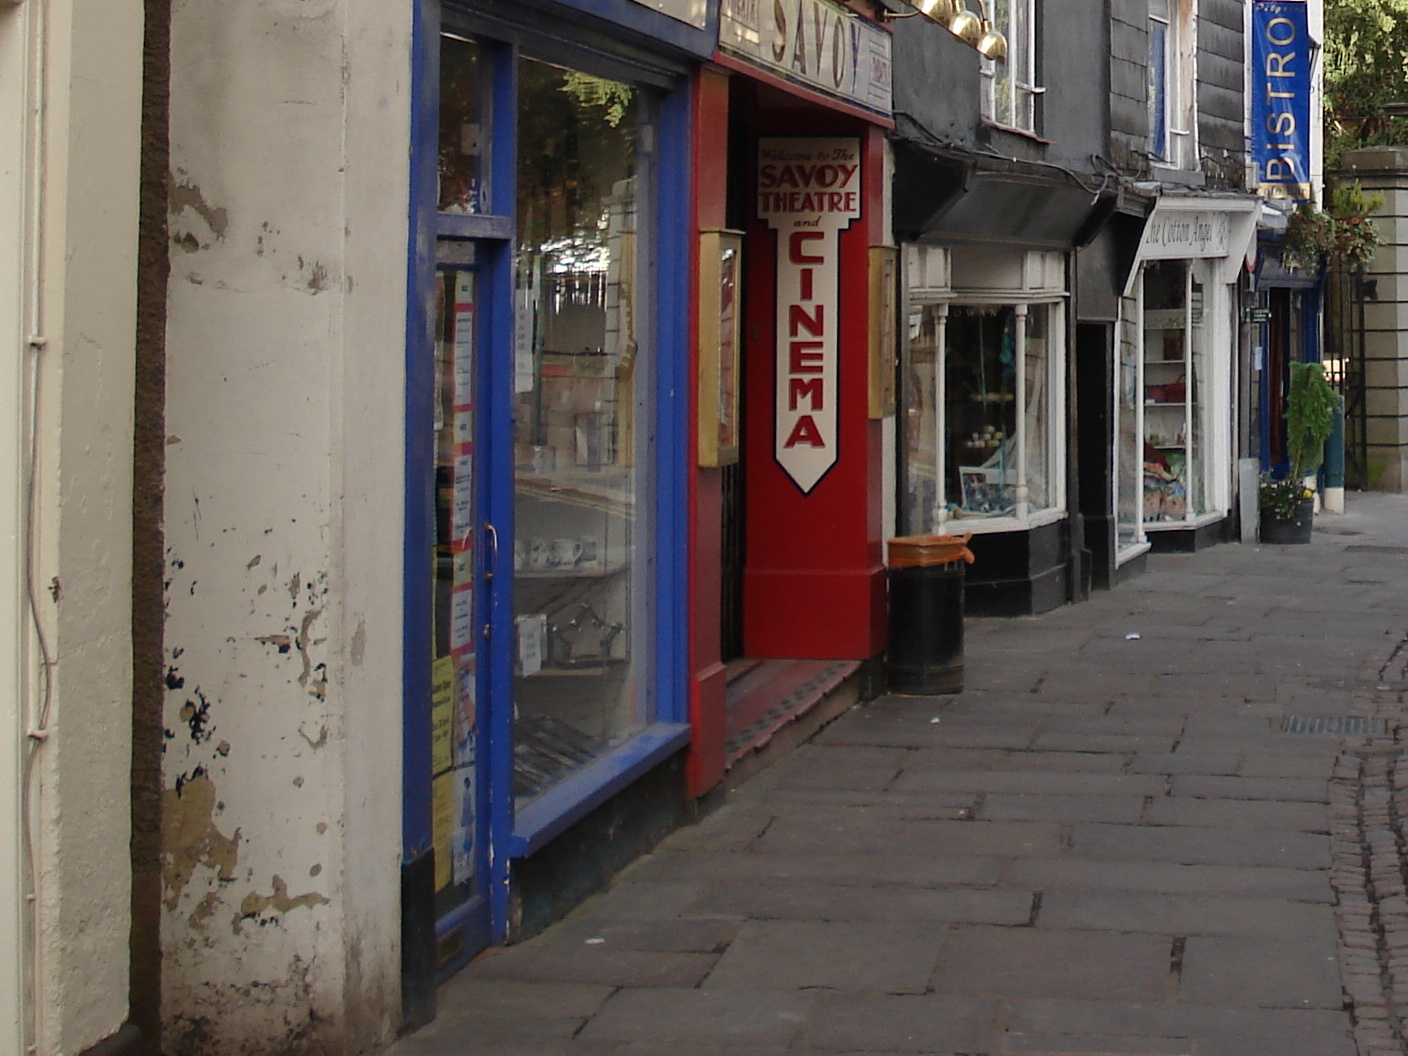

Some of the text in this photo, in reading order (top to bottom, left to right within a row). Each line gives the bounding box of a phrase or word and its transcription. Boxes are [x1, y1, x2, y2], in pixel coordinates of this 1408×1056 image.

[1265, 17, 1296, 181] BISTRO
[762, 148, 855, 161] Welcome to The
[760, 164, 858, 188] SAVOY
[759, 191, 857, 213] THEATRE
[793, 215, 822, 227] and
[1162, 216, 1190, 247] Cotton
[1189, 215, 1213, 252] Angel
[783, 230, 825, 449] CINEMA
